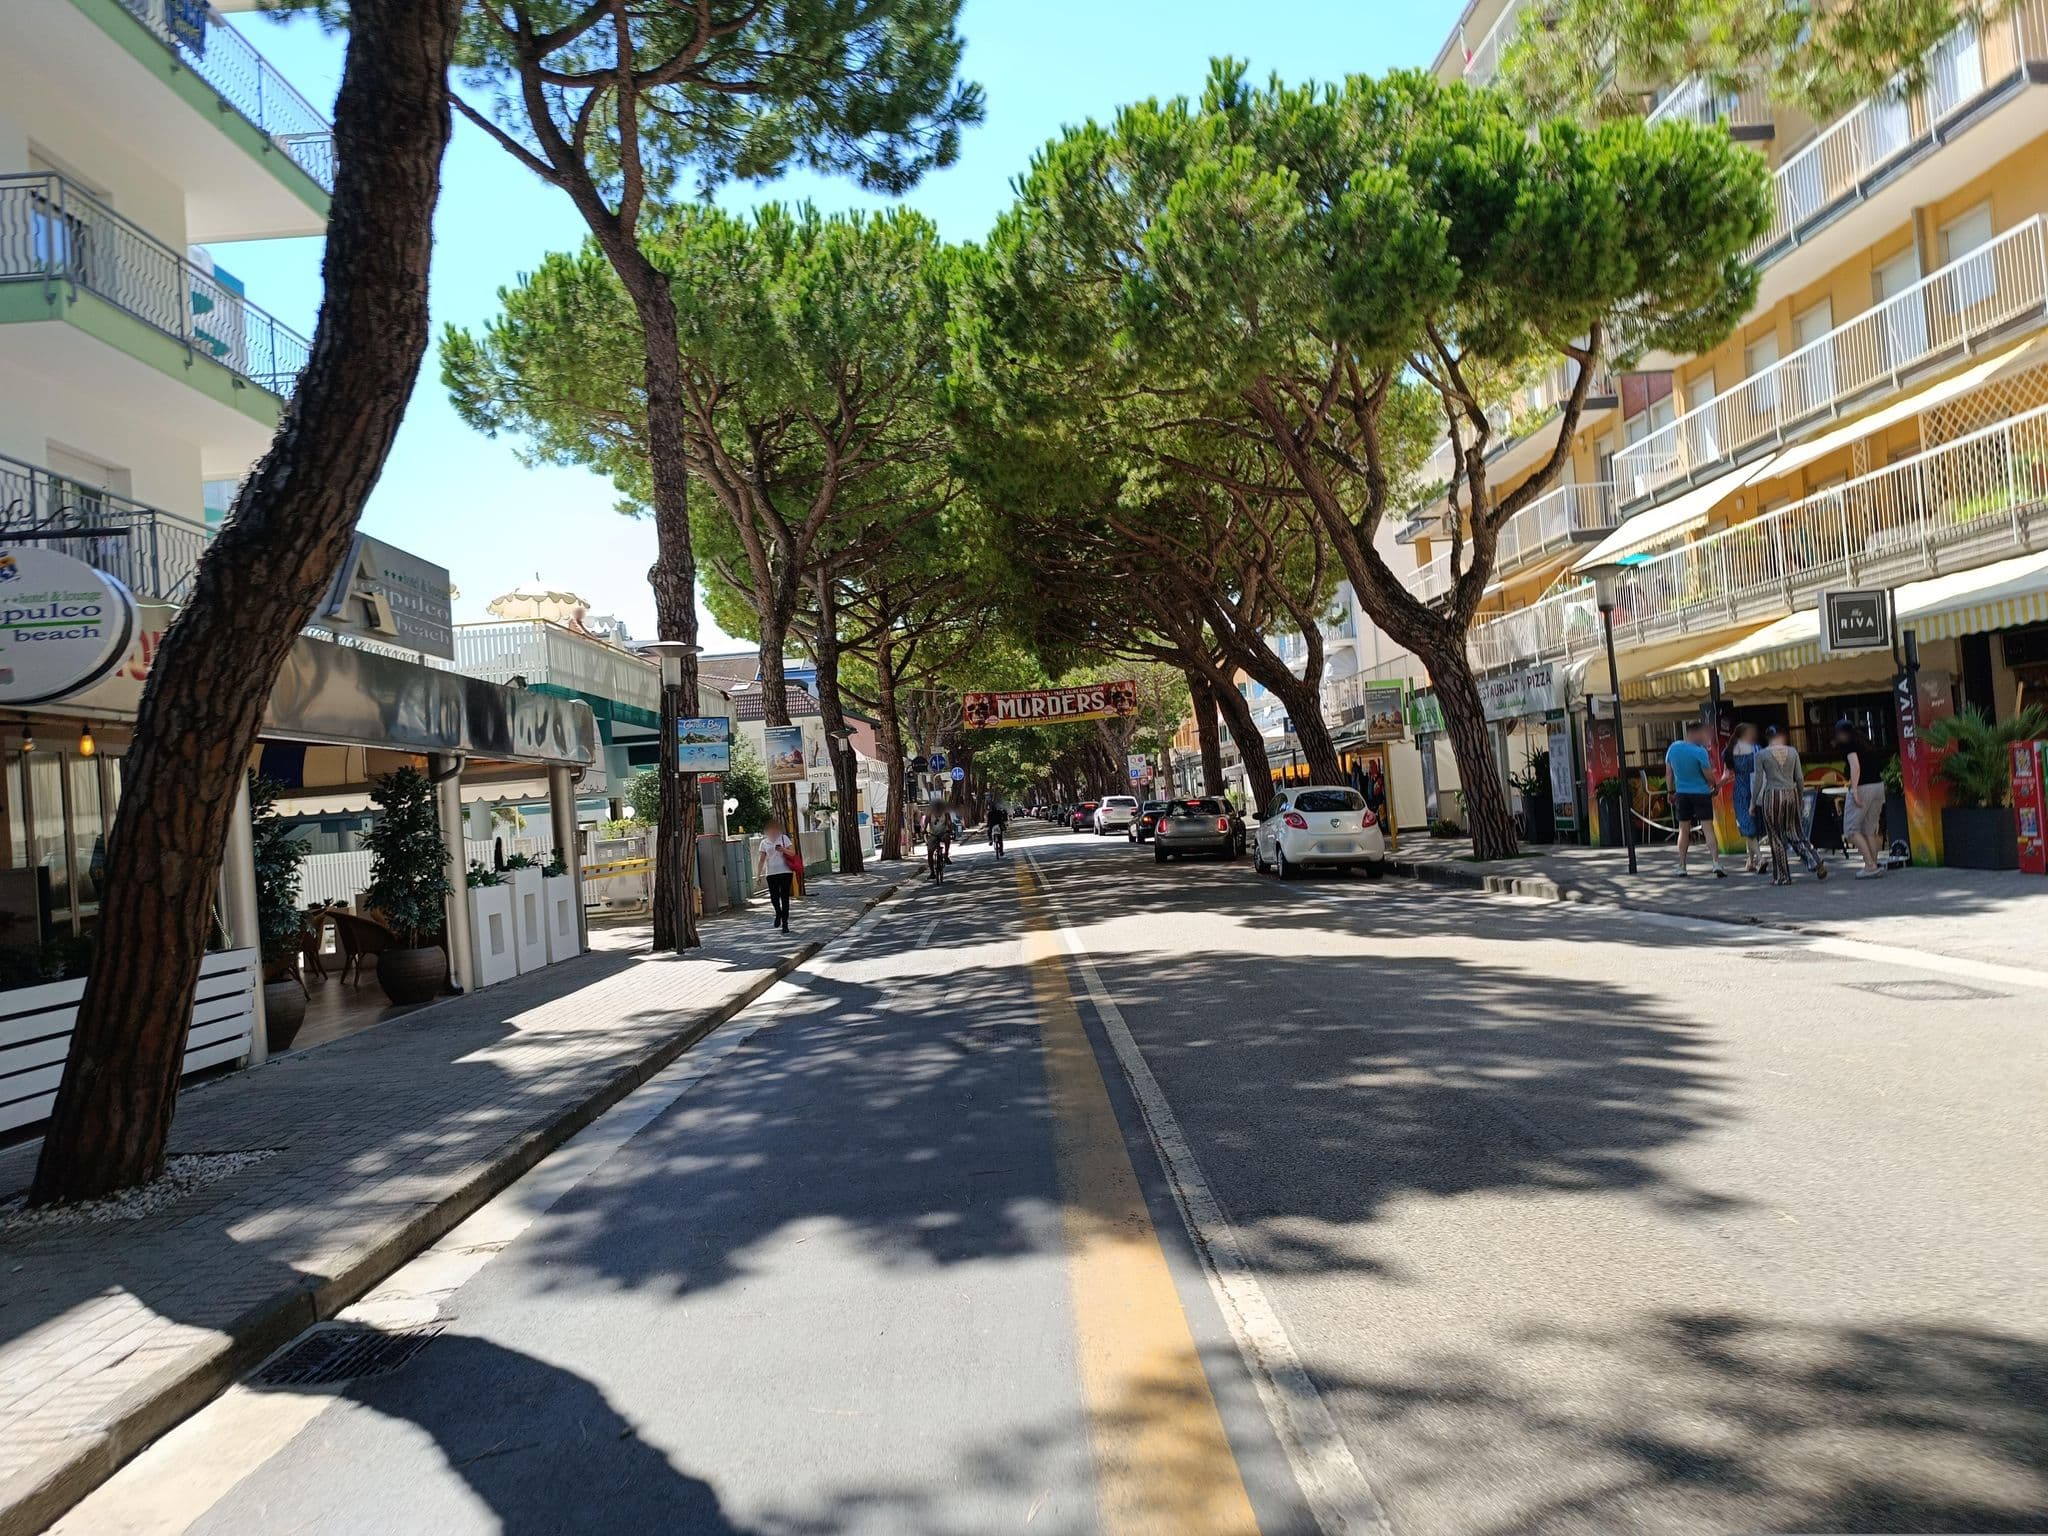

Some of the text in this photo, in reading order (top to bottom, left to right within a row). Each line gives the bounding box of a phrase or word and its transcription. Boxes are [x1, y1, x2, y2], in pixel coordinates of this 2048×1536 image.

[0, 603, 102, 624] pulco
[1840, 616, 1874, 629] RIVA
[14, 625, 101, 642] beach
[1478, 678, 1519, 701] ESTAURANT
[1526, 671, 1552, 689] PIZZA
[997, 691, 1105, 719] MURDERS
[1898, 678, 1914, 738] RIVA
